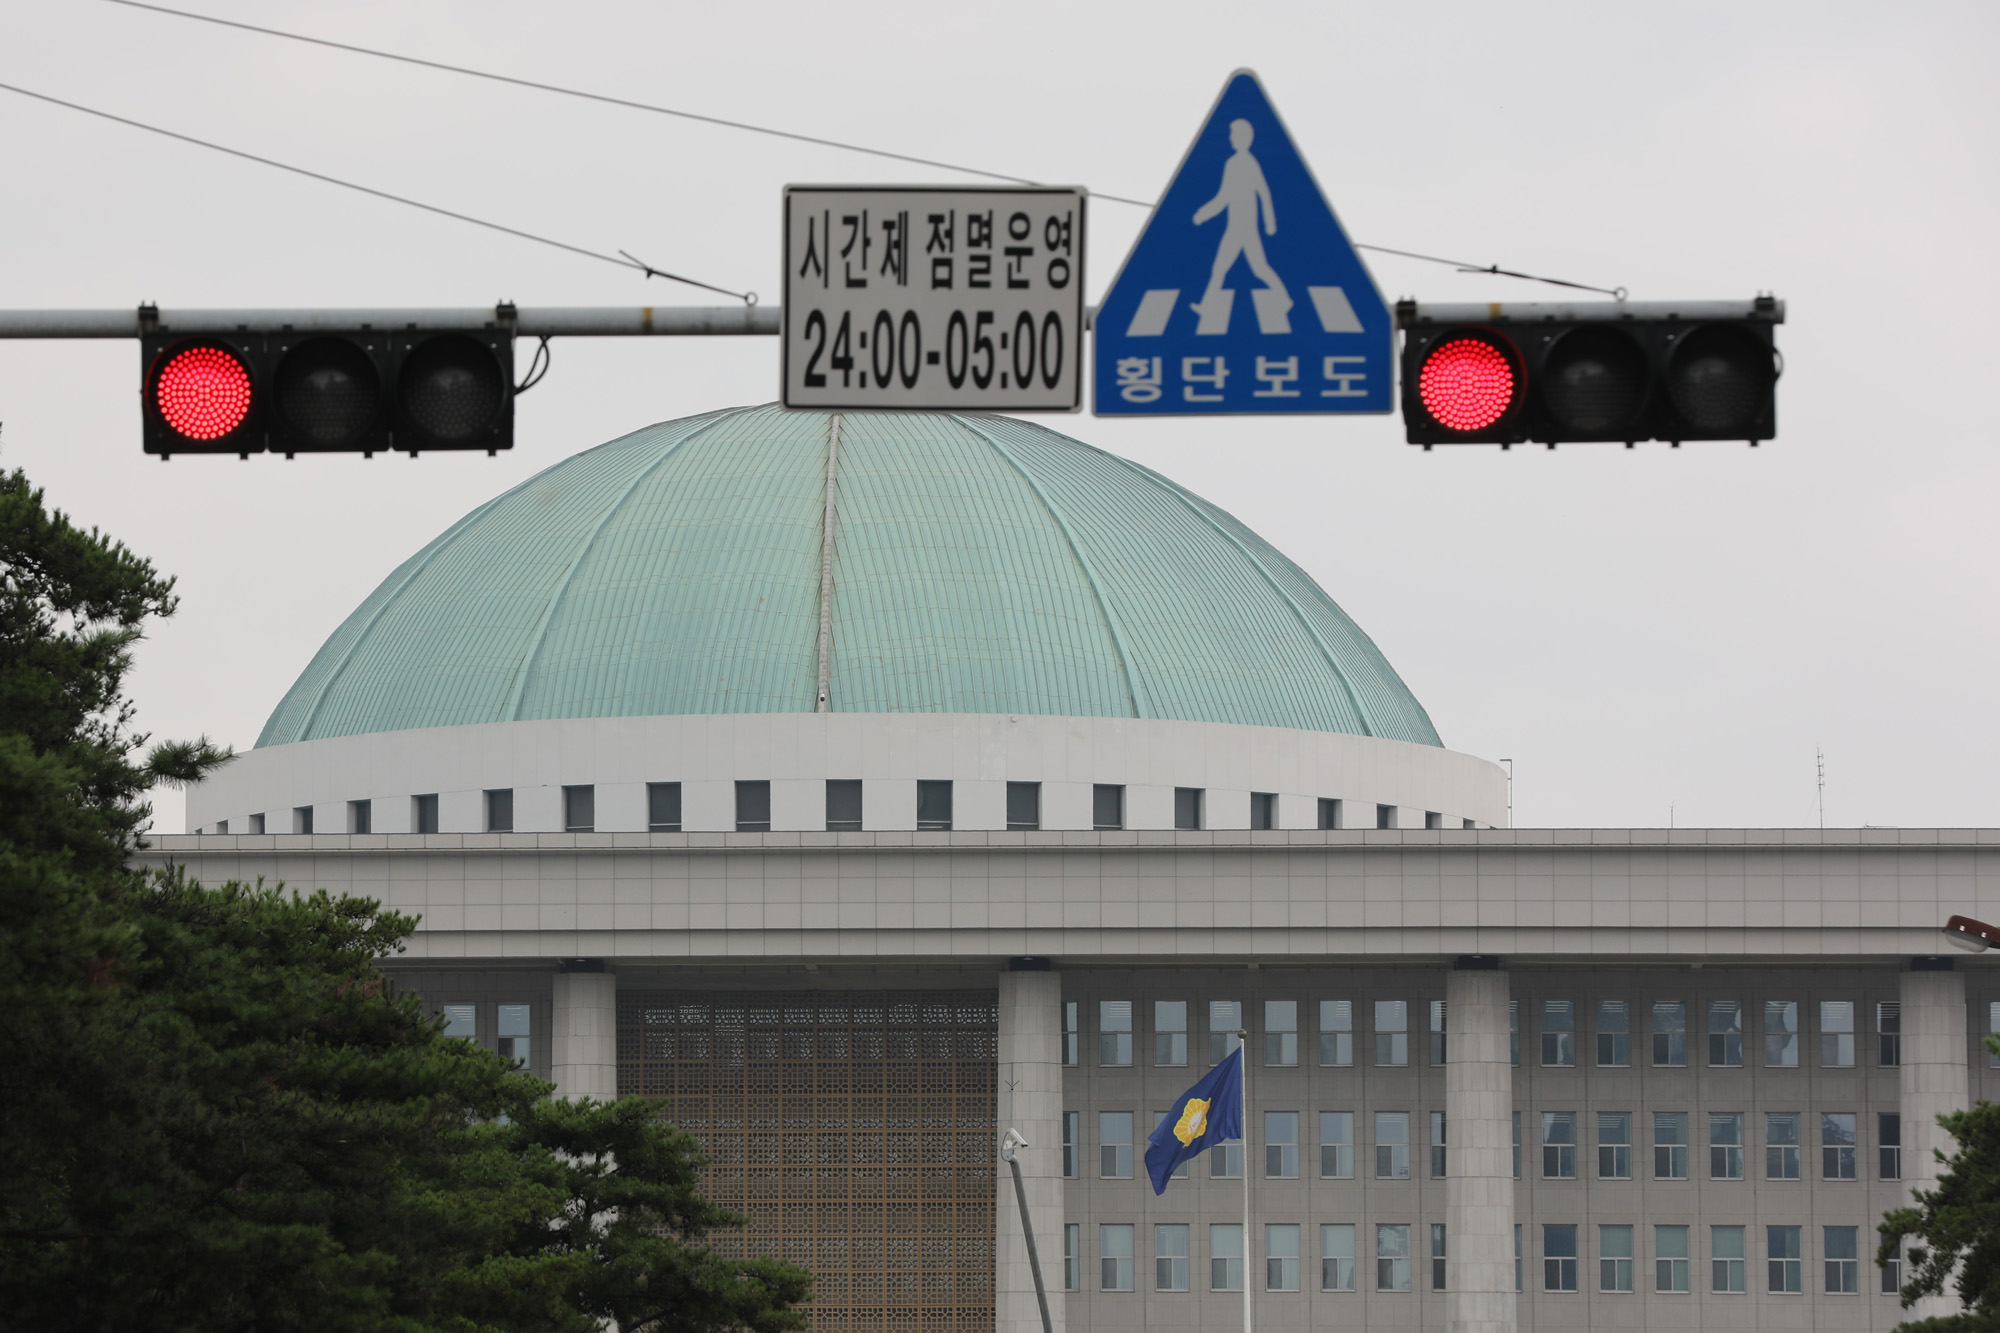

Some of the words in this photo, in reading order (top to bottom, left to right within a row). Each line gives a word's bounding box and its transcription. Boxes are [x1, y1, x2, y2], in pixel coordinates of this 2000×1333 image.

[799, 209, 909, 290] 시간제
[925, 209, 1073, 290] 점멸운영
[803, 308, 1064, 390] 24:00-05:00
[1115, 355, 1369, 403] 횡단보도
